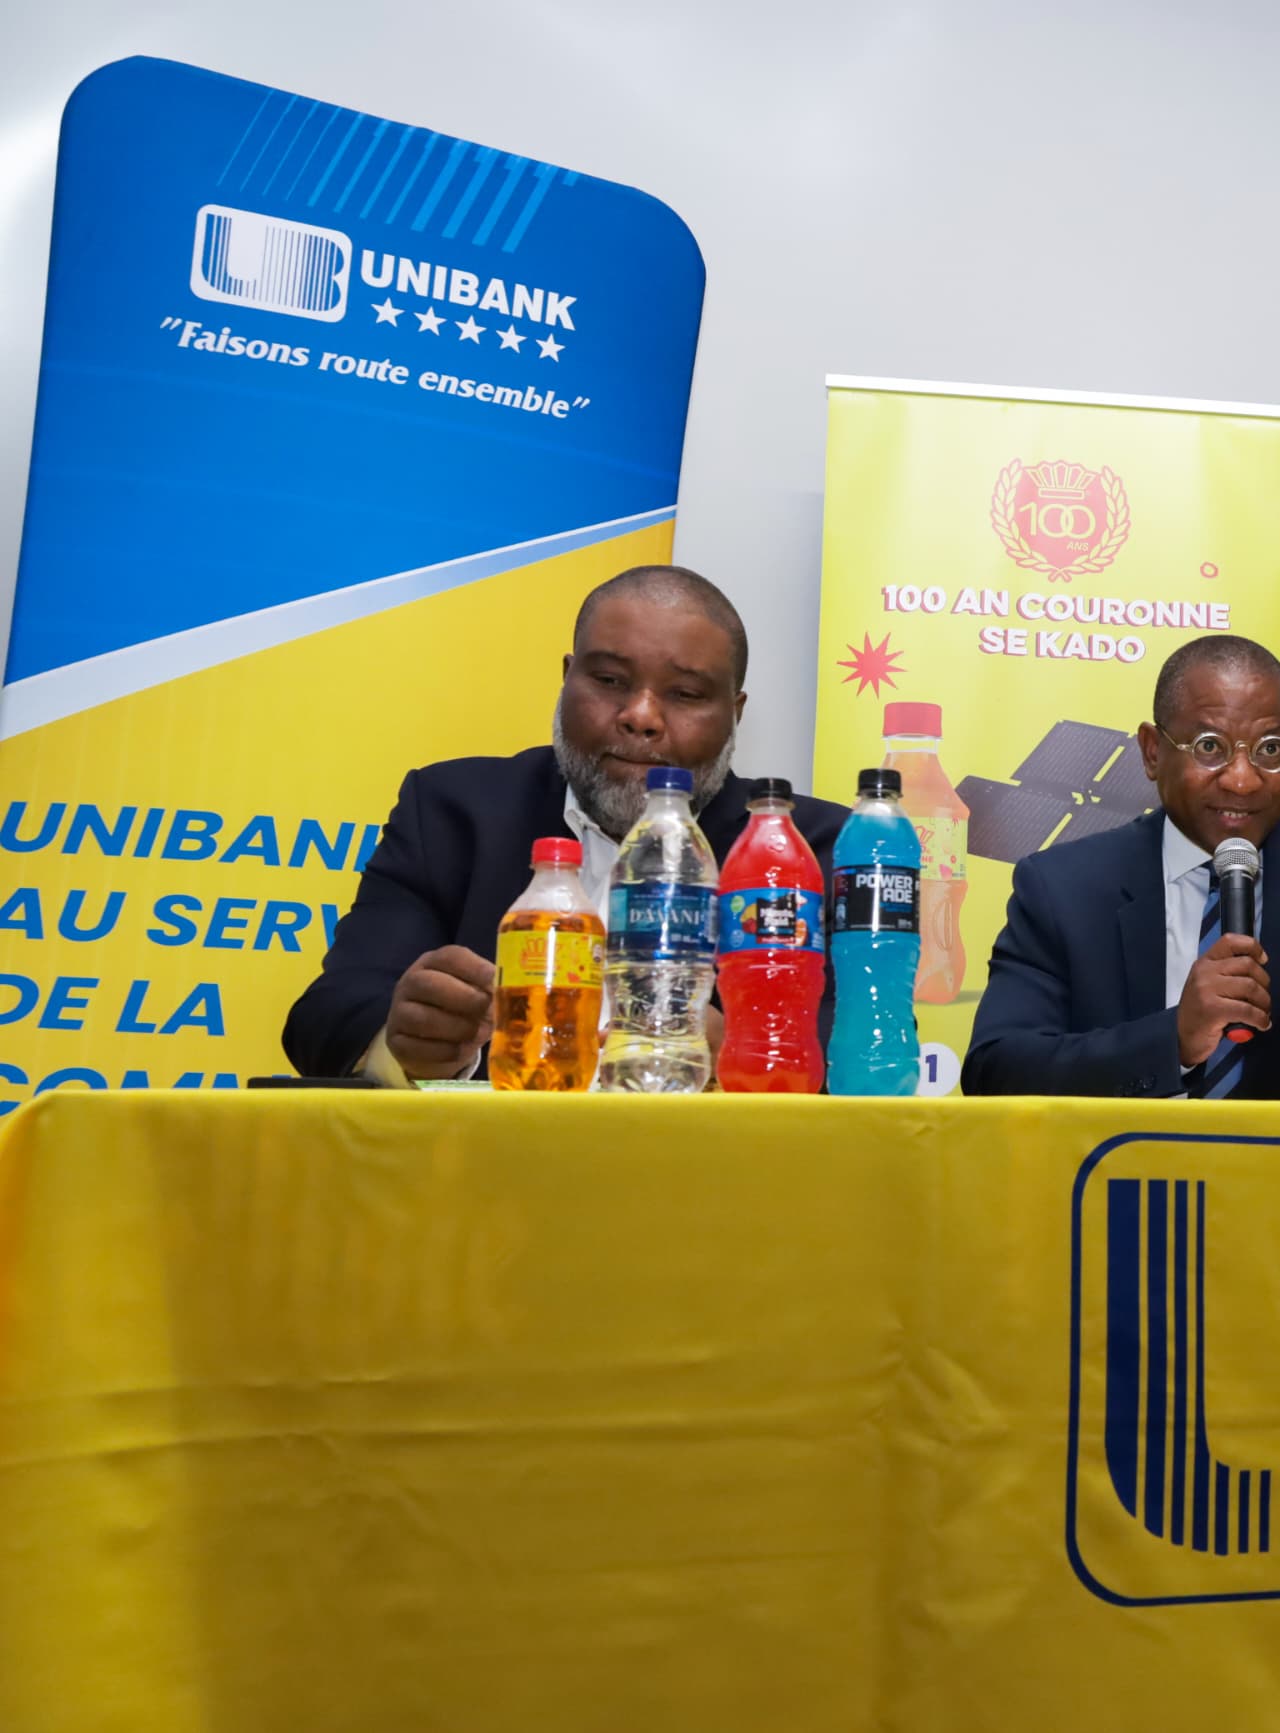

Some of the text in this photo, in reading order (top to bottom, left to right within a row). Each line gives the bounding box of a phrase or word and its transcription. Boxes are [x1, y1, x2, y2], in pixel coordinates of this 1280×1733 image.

[360, 249, 577, 332] UNIBANK
[318, 352, 409, 385] route
[1019, 501, 1096, 539] 100
[1066, 541, 1089, 552] ANS
[882, 584, 1231, 630] 100 AN COURONNE
[978, 625, 1146, 664] SE KADO
[855, 873, 913, 890] POWER
[882, 887, 913, 904] ADE
[0, 887, 126, 942] AU
[0, 973, 225, 1036] DE LA
[924, 1053, 938, 1083] 1
